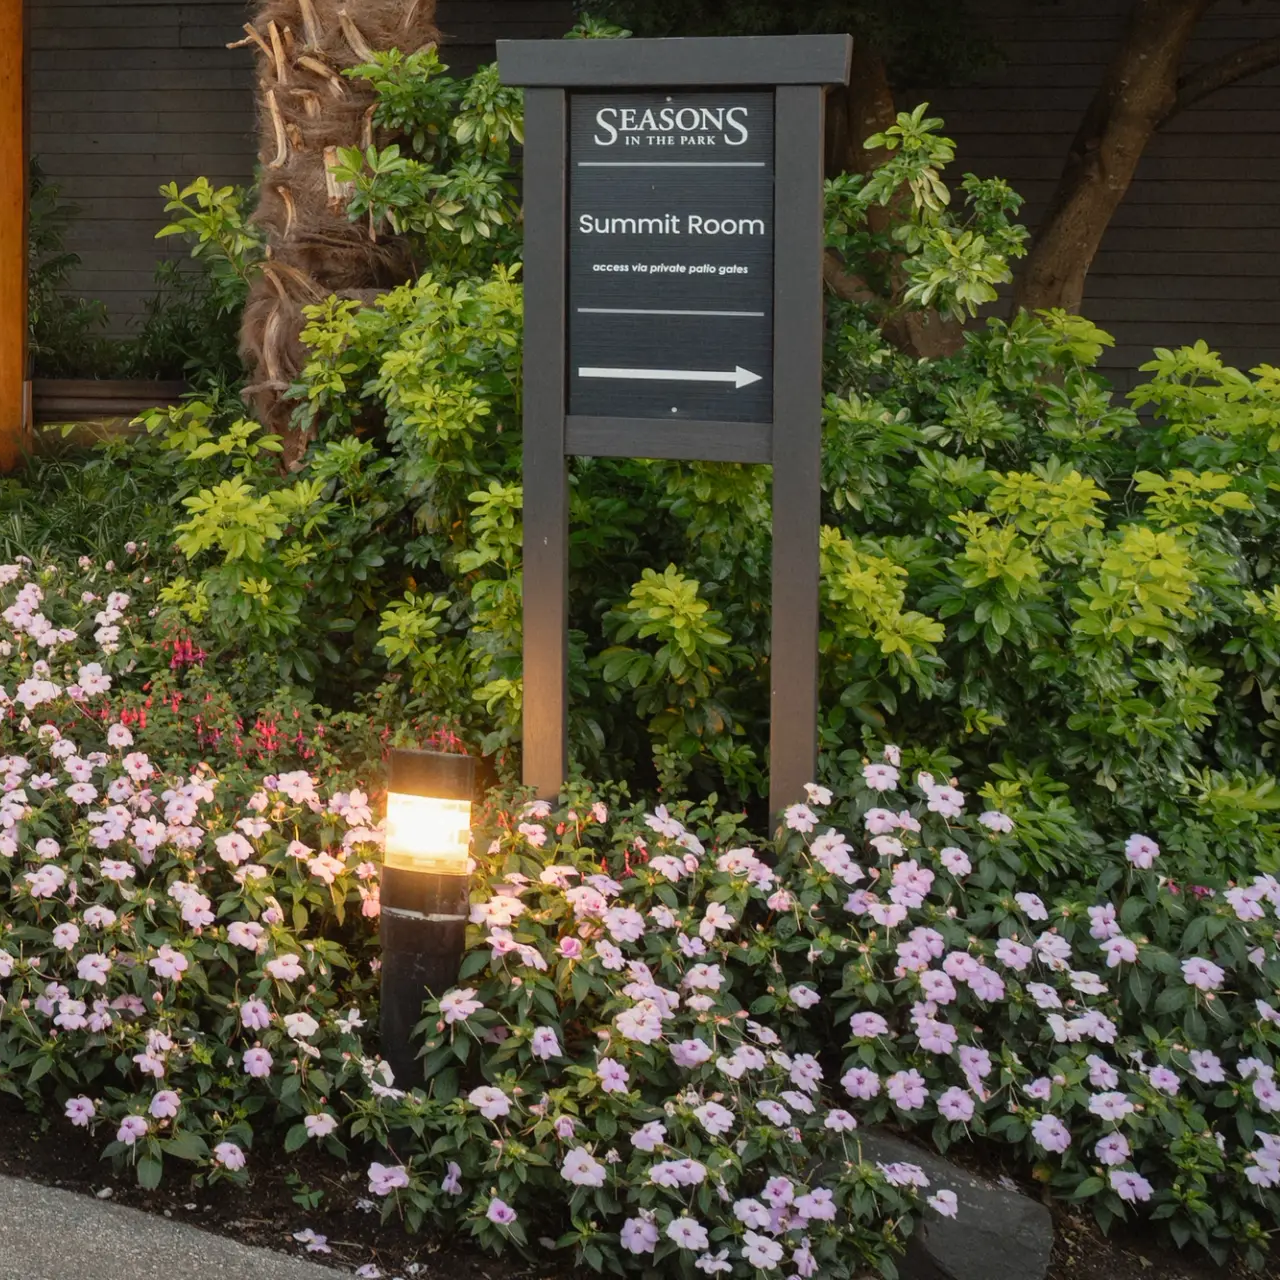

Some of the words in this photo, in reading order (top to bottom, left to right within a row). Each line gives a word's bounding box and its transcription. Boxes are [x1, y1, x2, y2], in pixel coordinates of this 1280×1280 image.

[594, 107, 749, 146] SEASONS
[625, 136, 640, 145] IN
[646, 136, 675, 145] THE
[680, 136, 716, 145] PARK
[579, 214, 680, 234] Summit
[688, 215, 765, 235] Room
[592, 263, 629, 272] access
[632, 263, 648, 272] via
[649, 263, 686, 274] private
[688, 264, 716, 274] patio
[718, 264, 749, 275] gates
